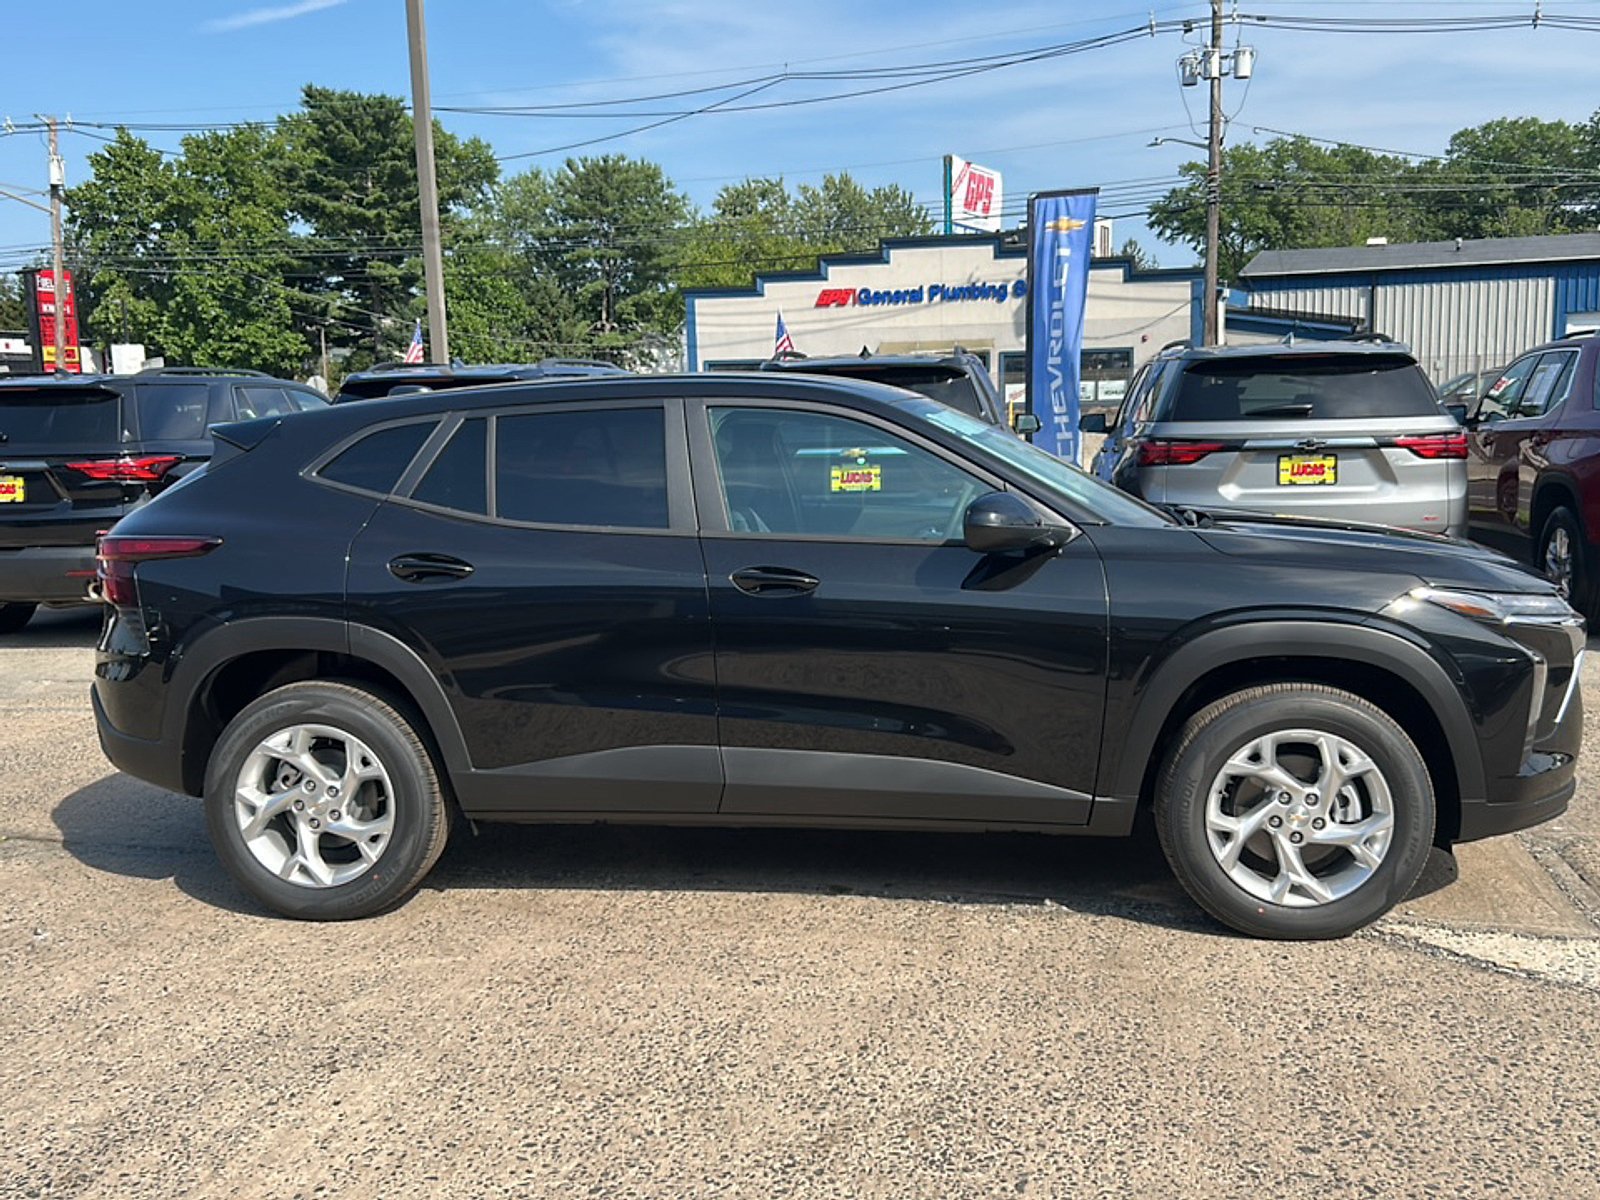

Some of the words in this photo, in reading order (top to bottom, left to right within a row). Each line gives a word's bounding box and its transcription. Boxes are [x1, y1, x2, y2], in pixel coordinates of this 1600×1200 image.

[964, 171, 995, 214] GPS
[814, 289, 854, 308] GPS
[857, 284, 924, 306] General
[928, 281, 1008, 303] Plumbing
[1045, 241, 1074, 465] CHEVROLET
[840, 470, 873, 484] LUCAS
[1290, 463, 1326, 476] LUCAS
